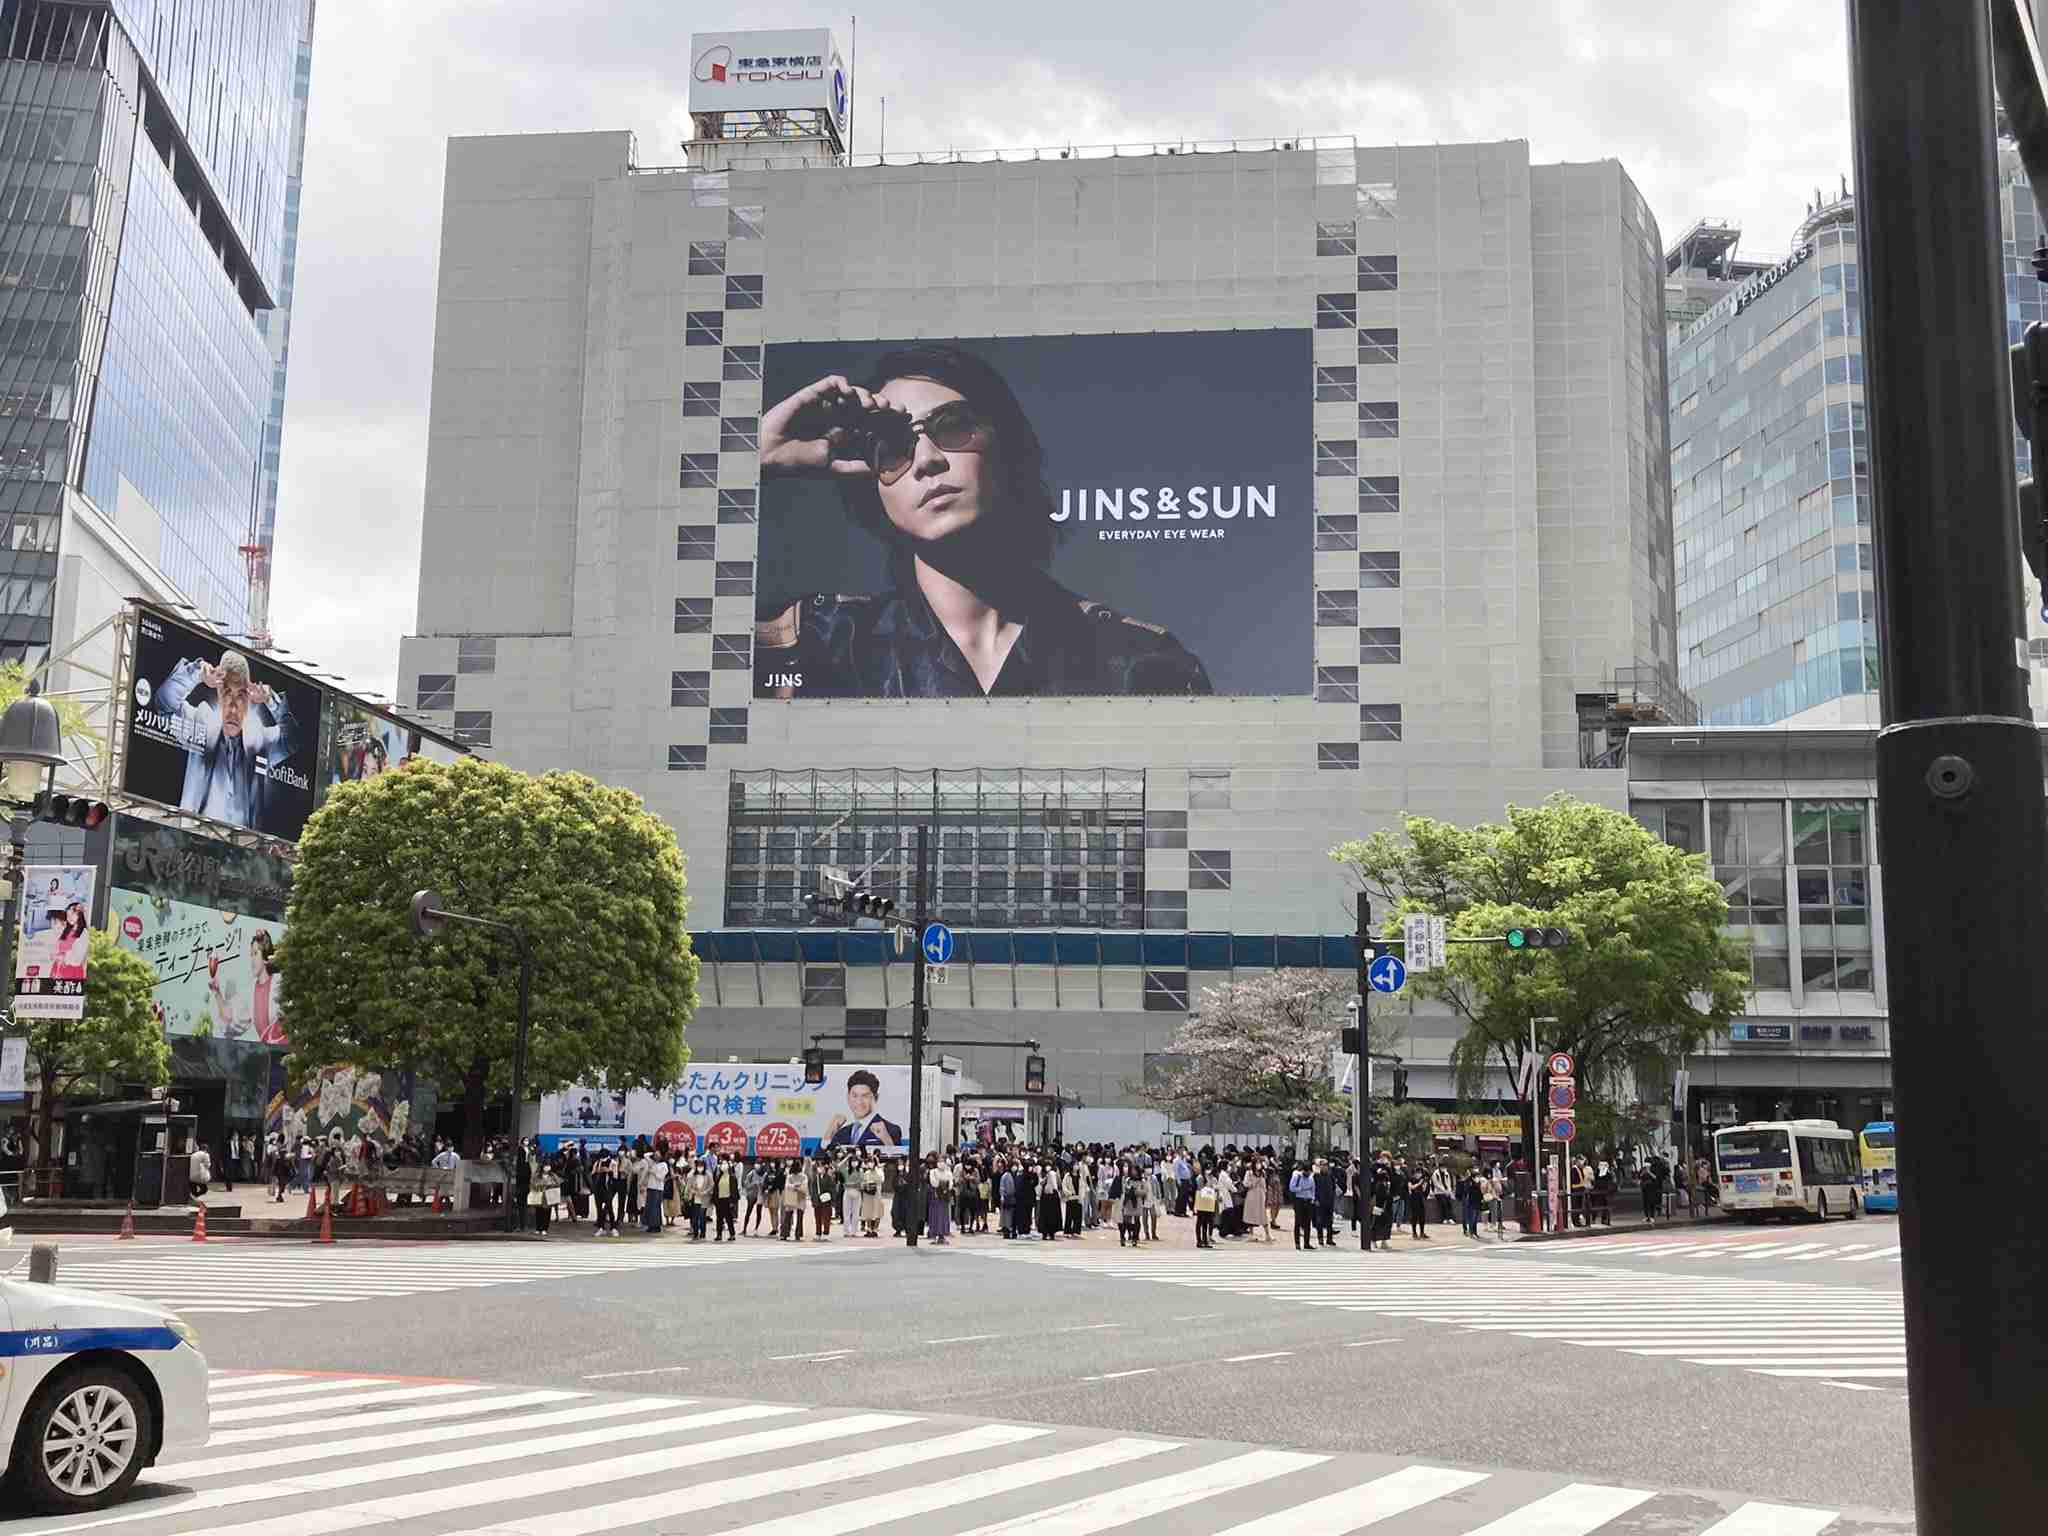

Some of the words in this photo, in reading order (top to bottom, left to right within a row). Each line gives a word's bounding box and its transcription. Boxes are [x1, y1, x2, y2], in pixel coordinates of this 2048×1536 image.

[738, 56, 823, 69] 東急東横店
[731, 69, 824, 82] TOKYU
[1049, 485, 1276, 522] JINS&SUN
[1099, 530, 1160, 540] EVERYDAY
[1164, 529, 1186, 539] EYE
[1190, 528, 1225, 539] WEAR
[268, 765, 310, 791] SoftBank
[672, 1094, 767, 1116] PCR検査
